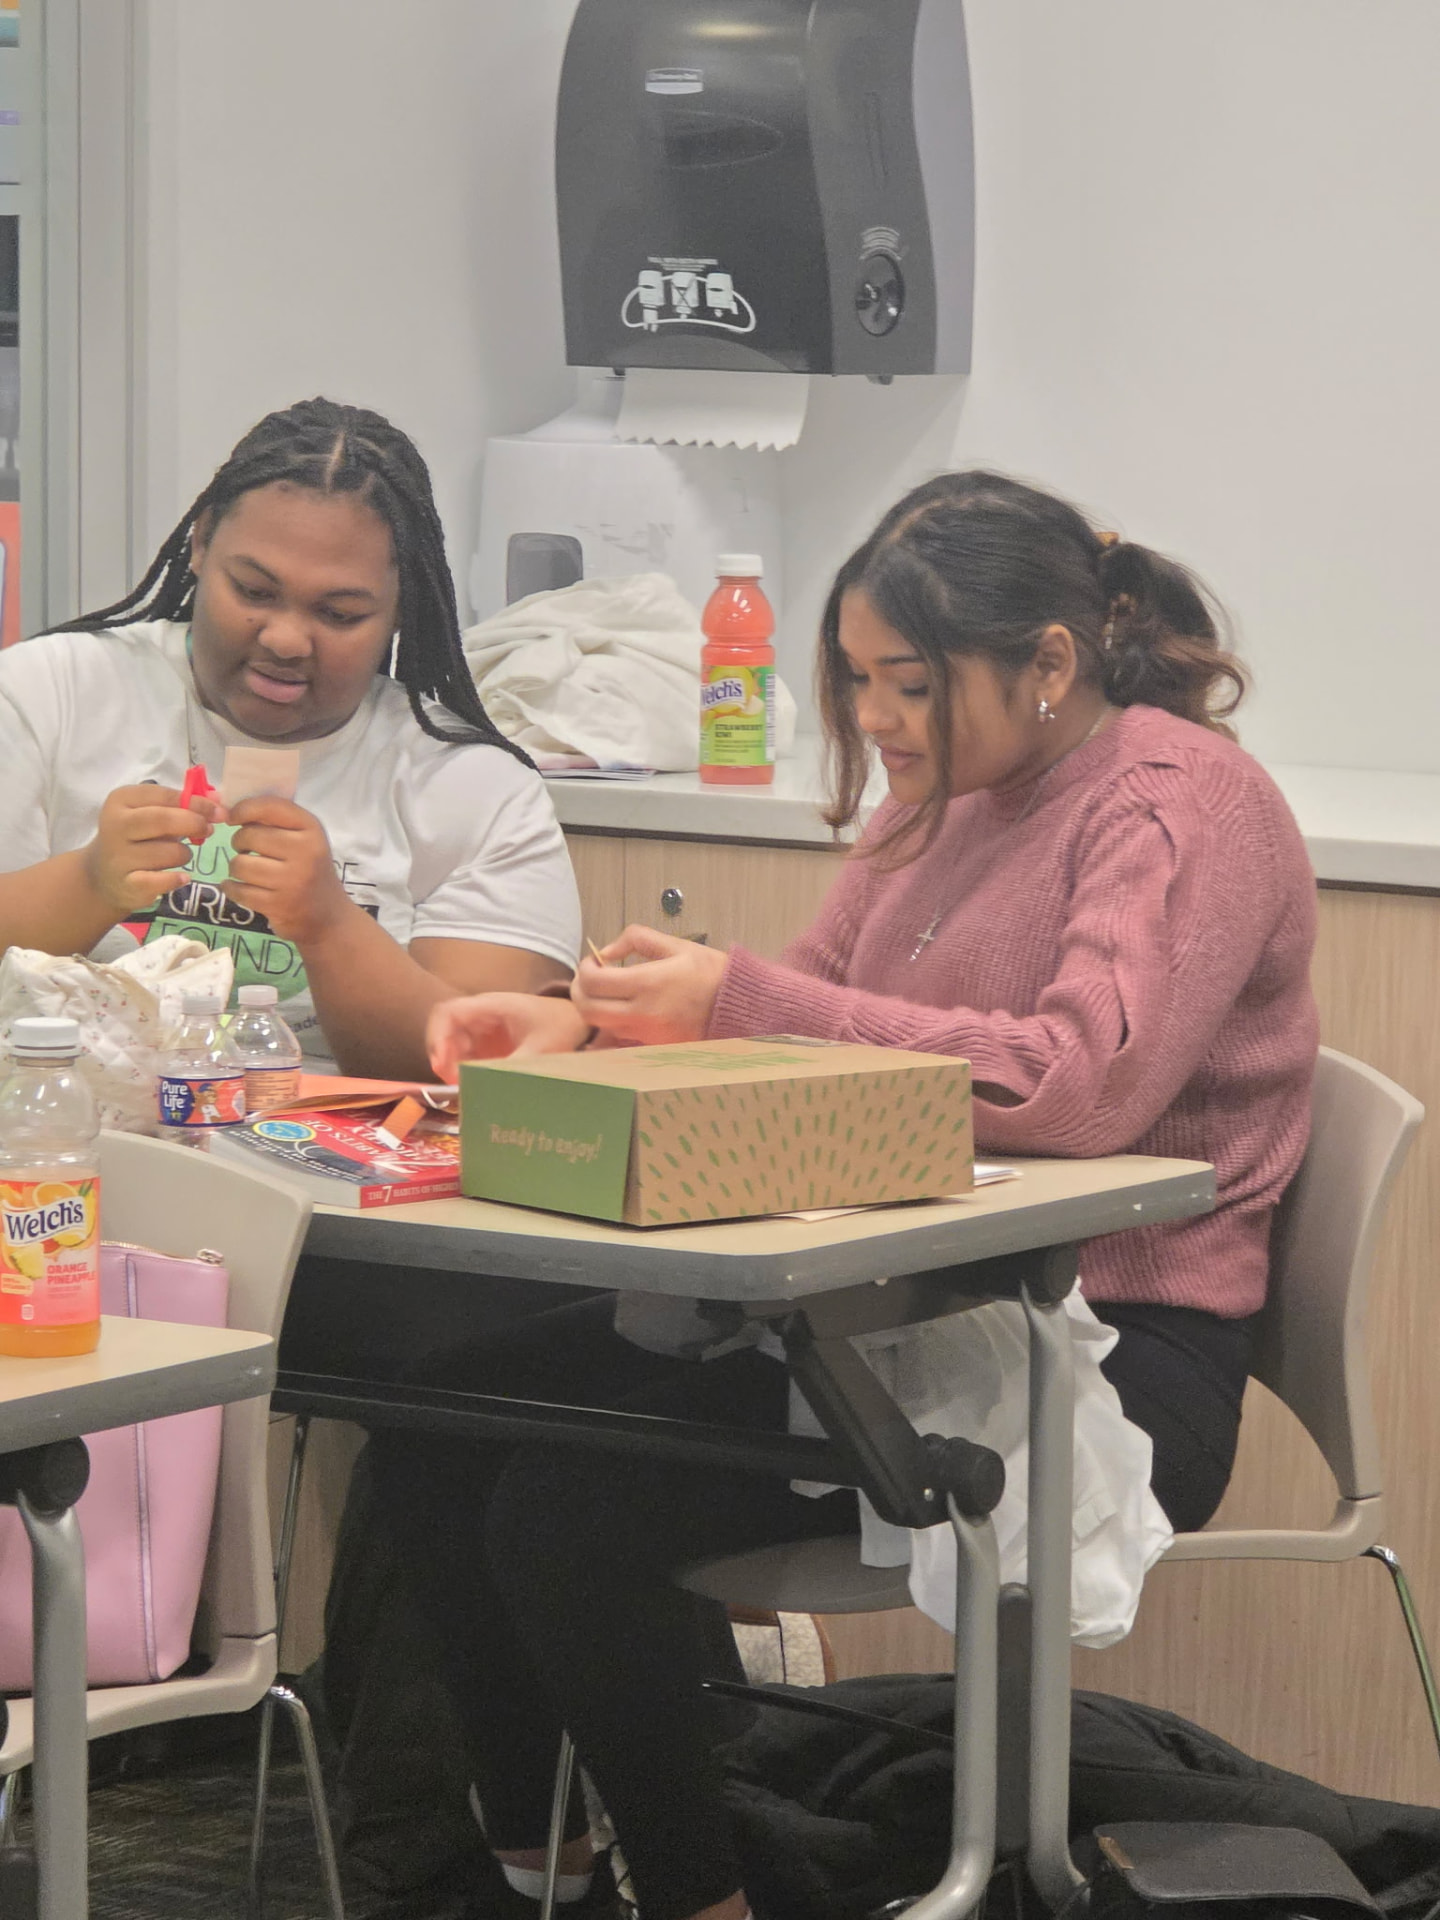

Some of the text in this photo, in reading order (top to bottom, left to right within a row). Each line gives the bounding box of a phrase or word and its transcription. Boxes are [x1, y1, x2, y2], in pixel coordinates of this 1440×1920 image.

[169, 882, 255, 925] GIRLS
[161, 923, 304, 978] OUND
[162, 1081, 188, 1096] Pure
[164, 1094, 185, 1111] Life
[490, 1123, 535, 1156] Ready
[538, 1131, 553, 1152] to
[555, 1133, 603, 1164] enjoy!
[382, 1185, 393, 1203] 7
[5, 1200, 84, 1240] Welch's
[47, 1262, 88, 1275] ORANGE
[47, 1271, 97, 1285] PINEAPPLE
